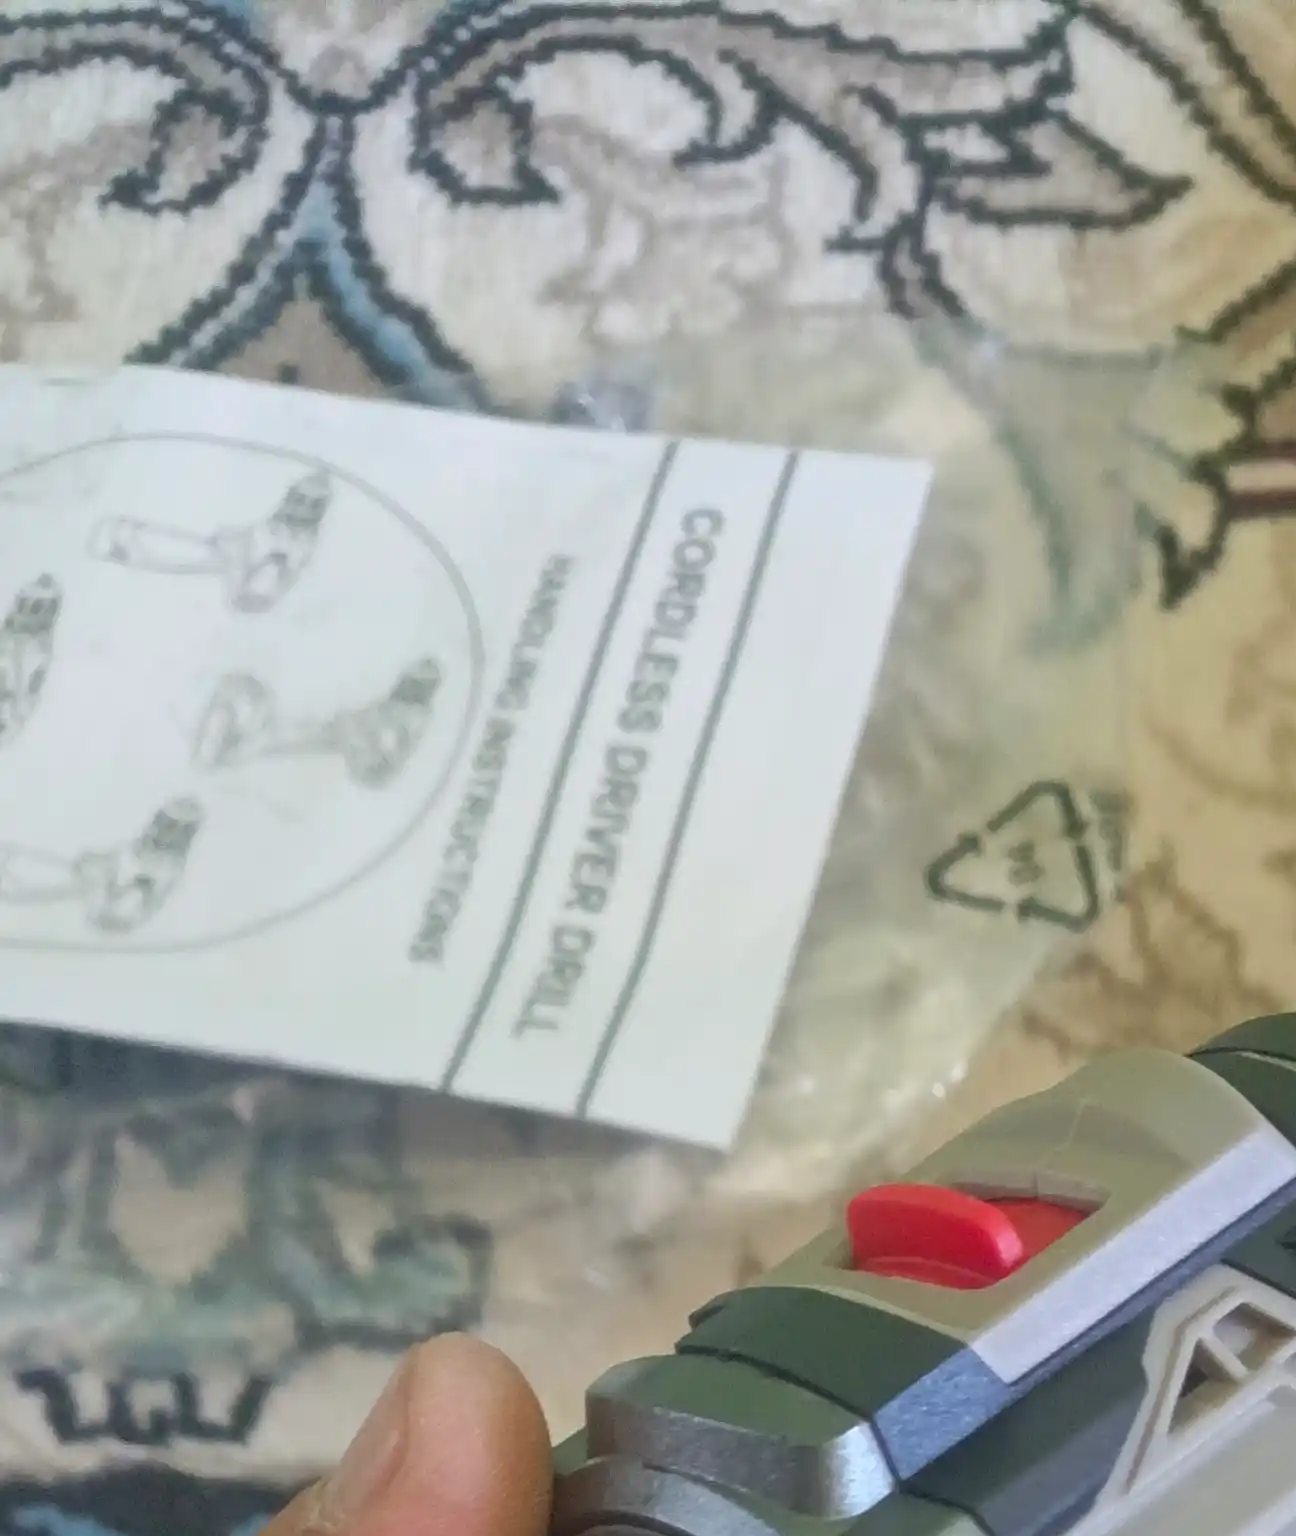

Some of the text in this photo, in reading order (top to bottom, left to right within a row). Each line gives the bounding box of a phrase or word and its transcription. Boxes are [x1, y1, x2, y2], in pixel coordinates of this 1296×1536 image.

[408, 553, 575, 964] HANDLING INSTRUCTIONS
[510, 506, 726, 1040] CORDLESS DRIVER DRILL
